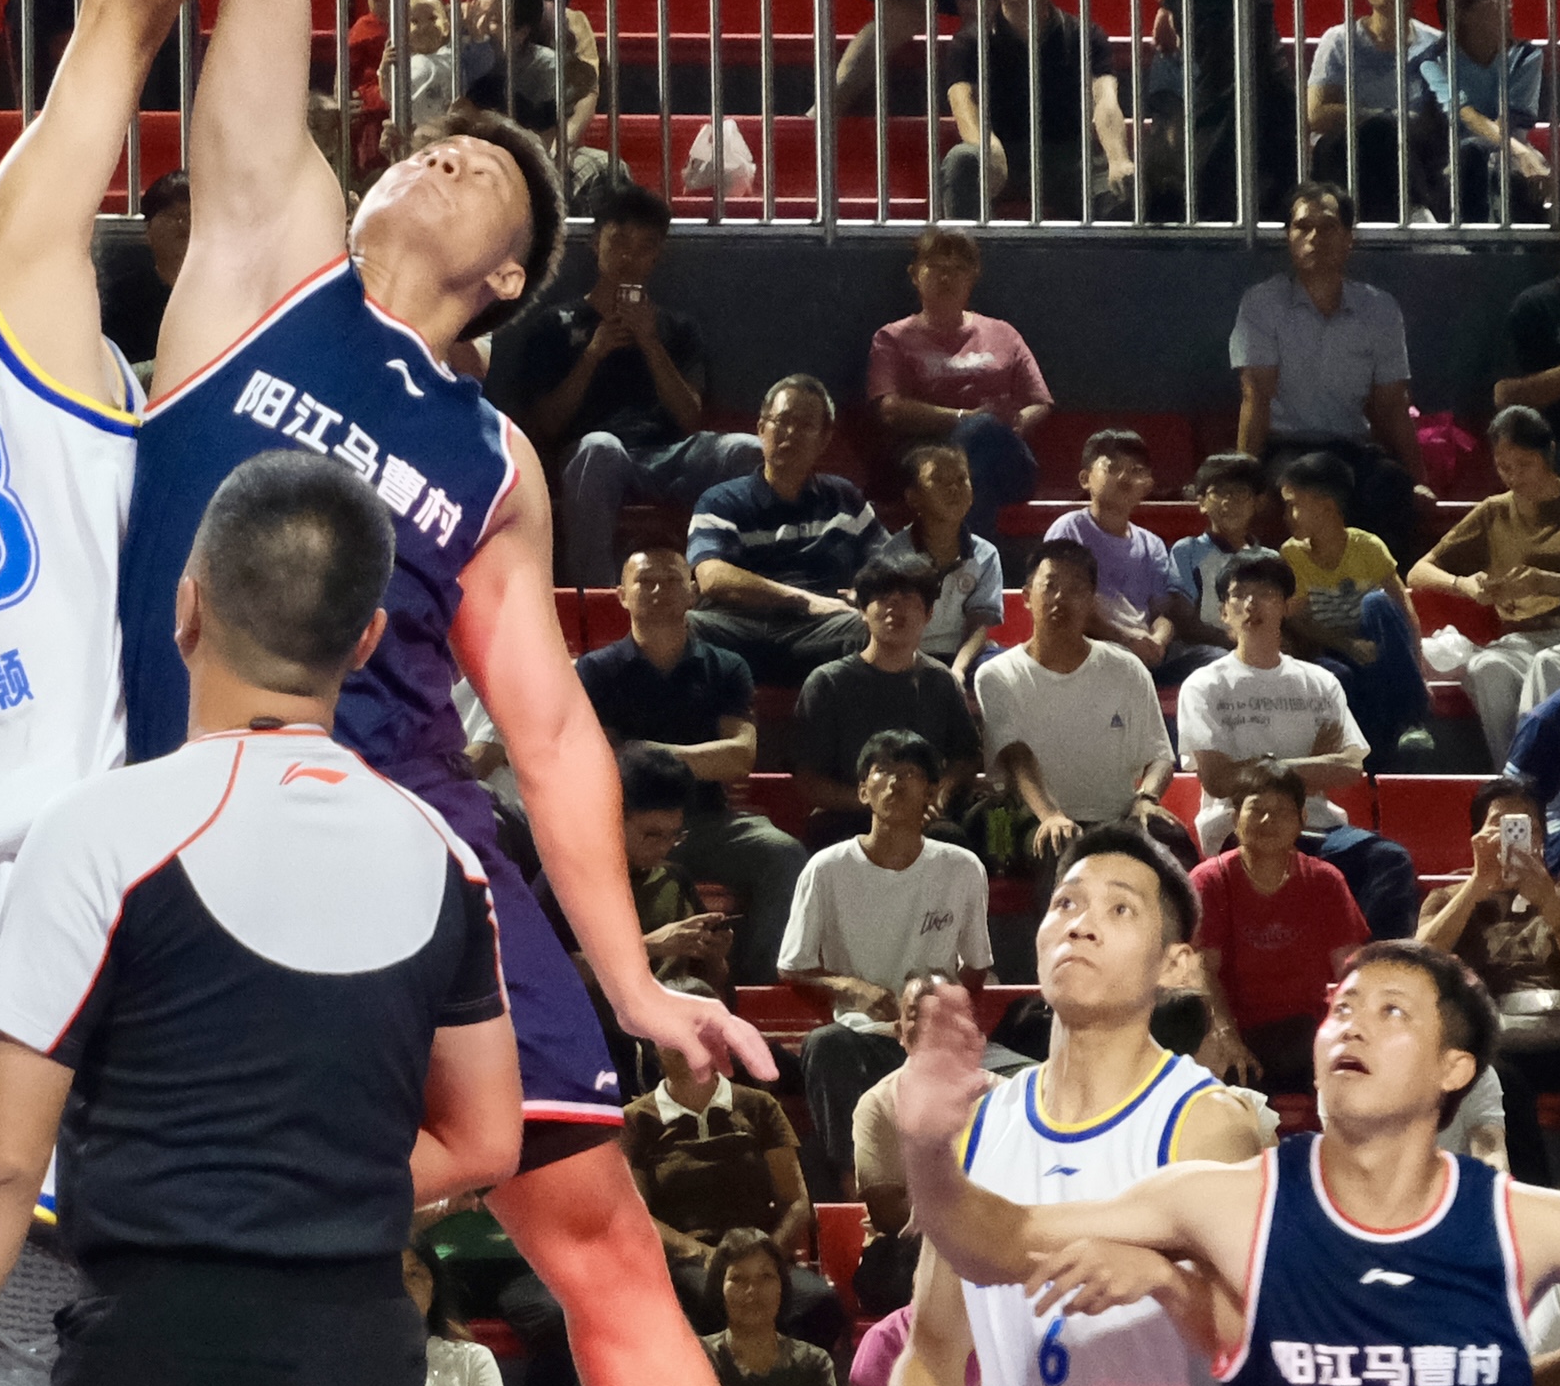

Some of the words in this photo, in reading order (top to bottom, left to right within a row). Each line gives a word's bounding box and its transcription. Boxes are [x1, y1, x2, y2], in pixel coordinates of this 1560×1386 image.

[233, 369, 462, 548] 阳江马曹村
